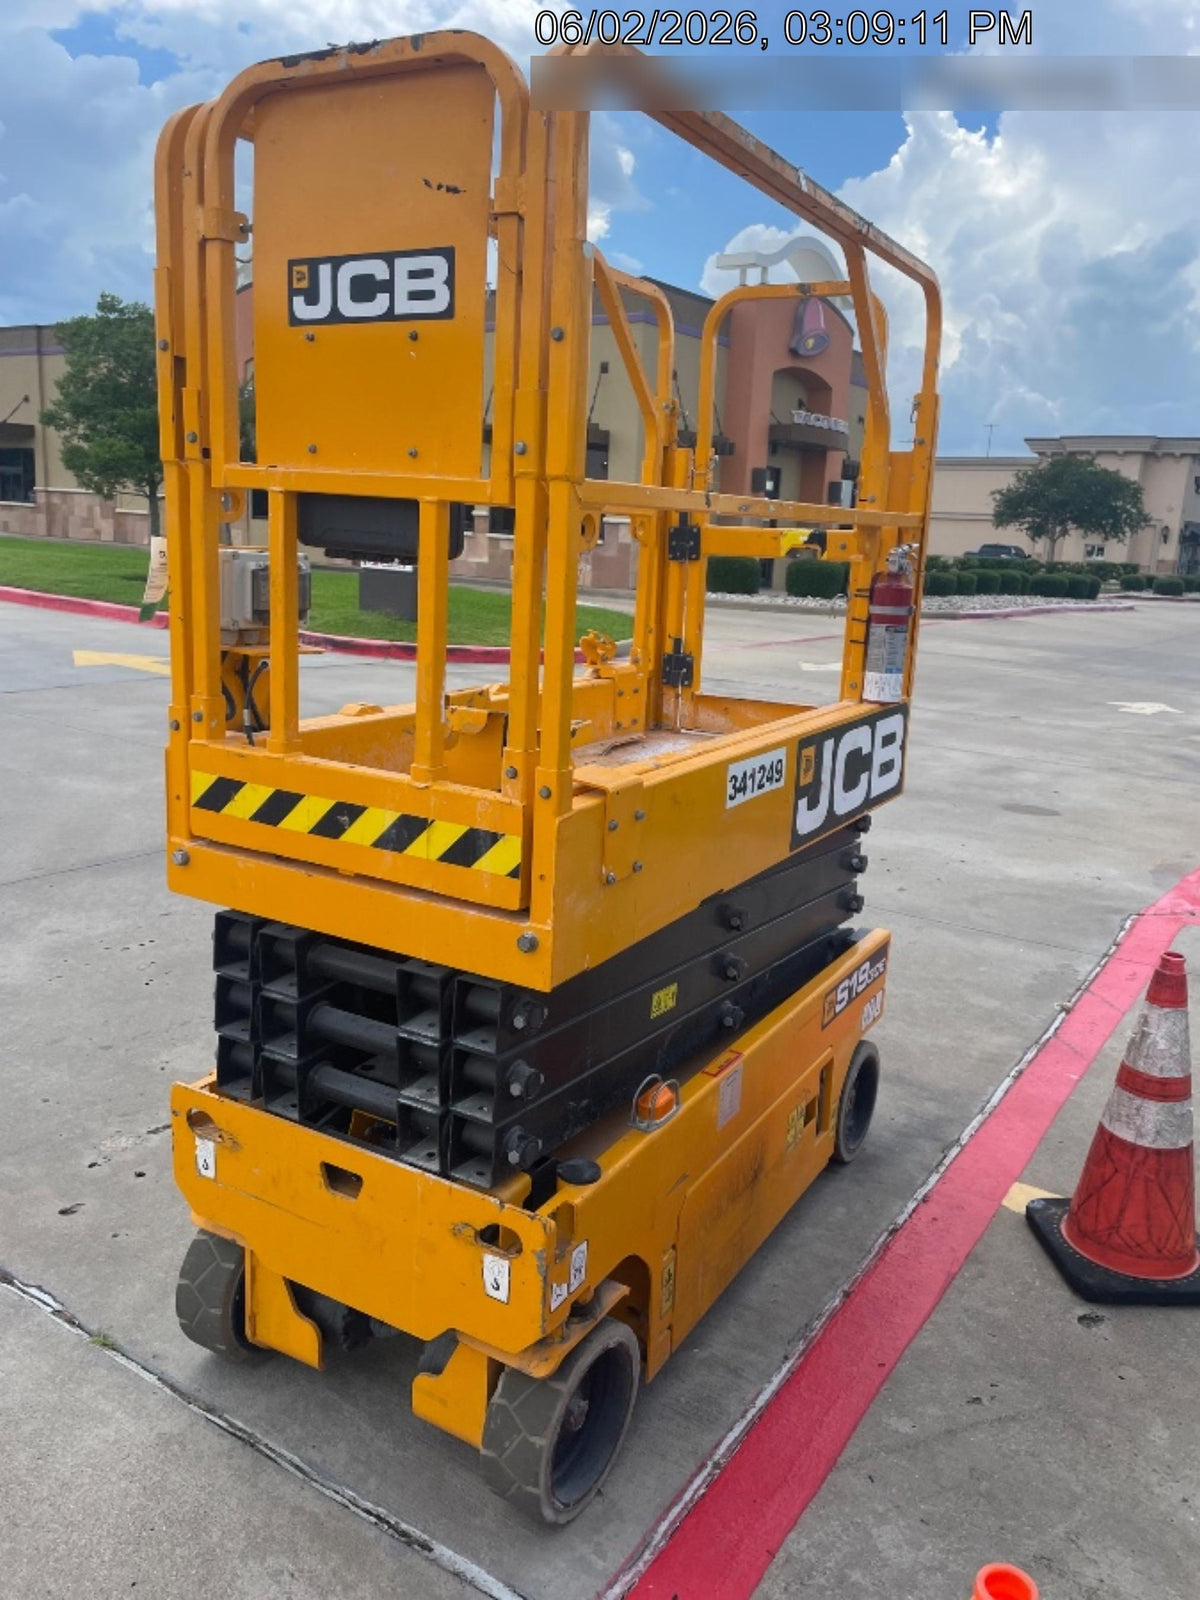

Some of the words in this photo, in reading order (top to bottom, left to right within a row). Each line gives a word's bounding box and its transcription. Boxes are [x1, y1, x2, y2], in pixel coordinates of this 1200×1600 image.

[292, 255, 450, 320] JCB
[728, 758, 783, 801] 341249
[796, 713, 904, 835] JCB
